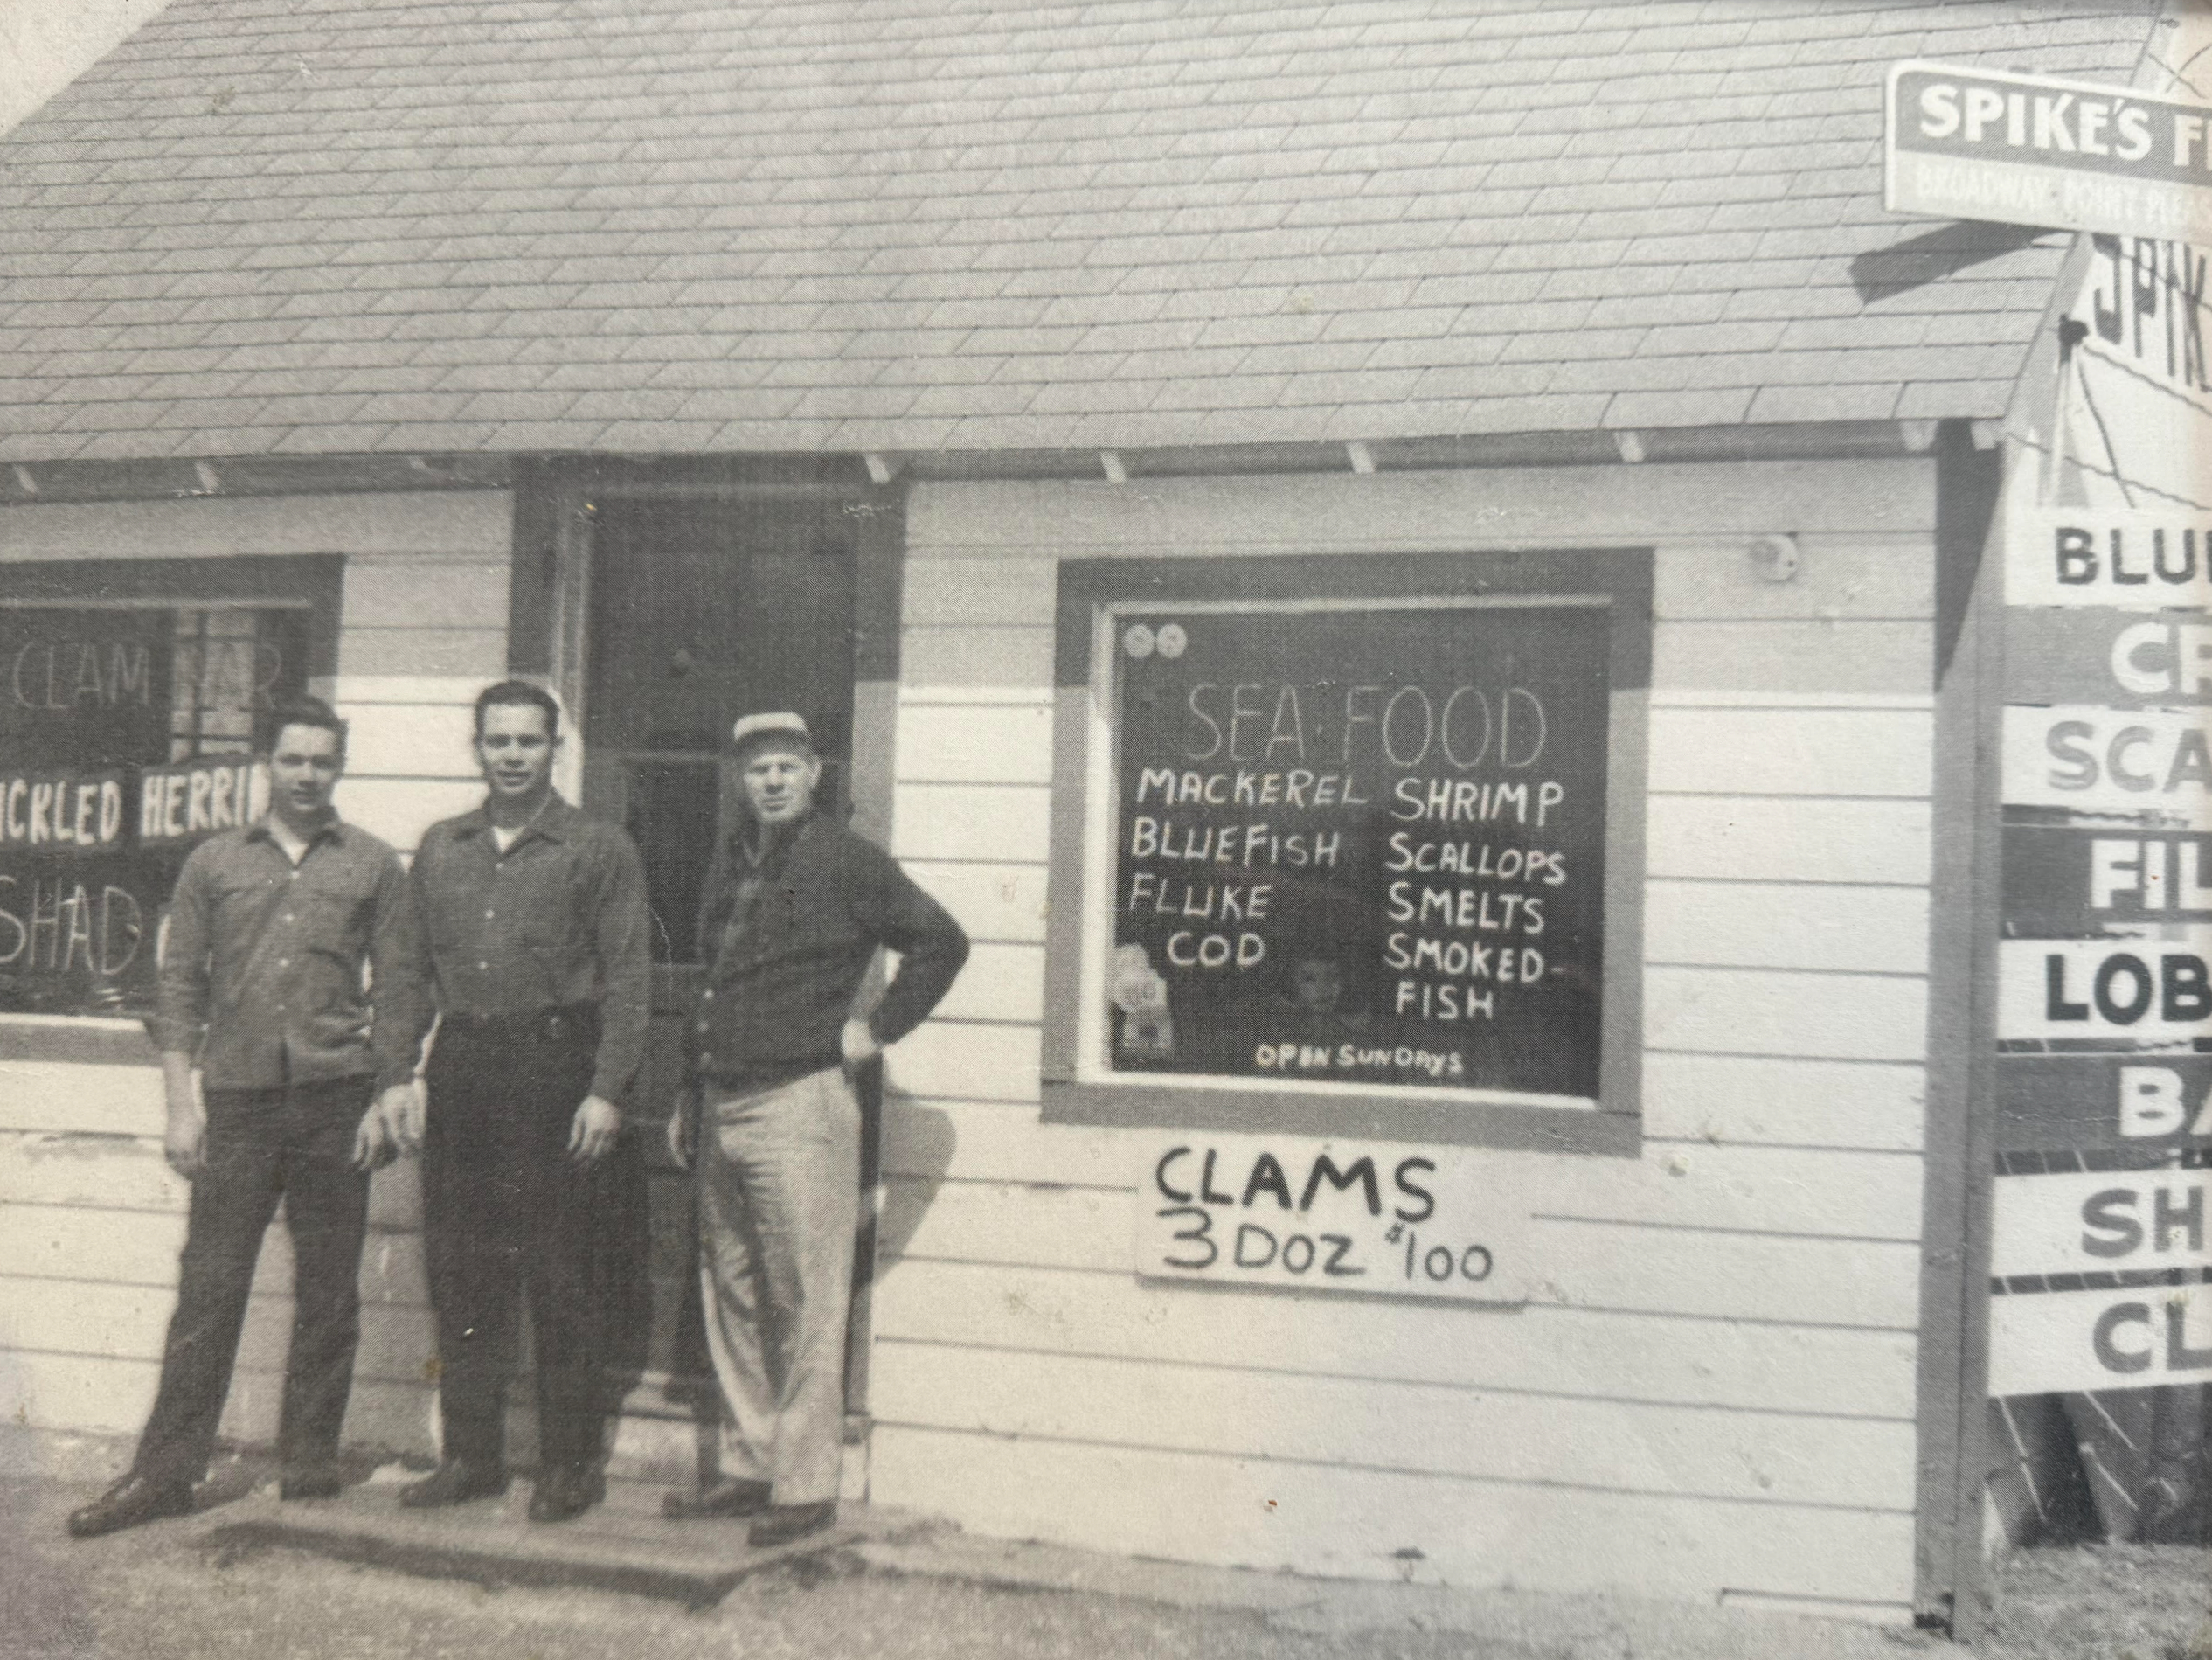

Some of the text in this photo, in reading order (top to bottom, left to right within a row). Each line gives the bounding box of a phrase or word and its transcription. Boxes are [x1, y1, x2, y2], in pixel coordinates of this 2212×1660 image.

[1920, 85, 2152, 161] SPIKE'S
[2055, 526, 2212, 586] BLU
[10, 641, 150, 711] CLAM
[1187, 684, 1547, 770] SEA FOOD
[1136, 768, 1369, 808] MACKEREL
[1390, 777, 1564, 826] SHRIMP
[1131, 817, 1340, 867] BLUEFISH
[1384, 832, 1567, 886] SCALLOPS
[1129, 873, 1272, 921] FLUKE
[1386, 881, 1545, 935] SMELTS
[1167, 931, 1265, 967] COD
[1397, 980, 1494, 1021] FISH
[2044, 952, 2212, 1027] LOB
[1255, 1043, 1331, 1070] OPEN
[1155, 1146, 1436, 1224] CLAMS
[1155, 1206, 1218, 1269] 3
[2080, 1184, 2203, 1260] SH
